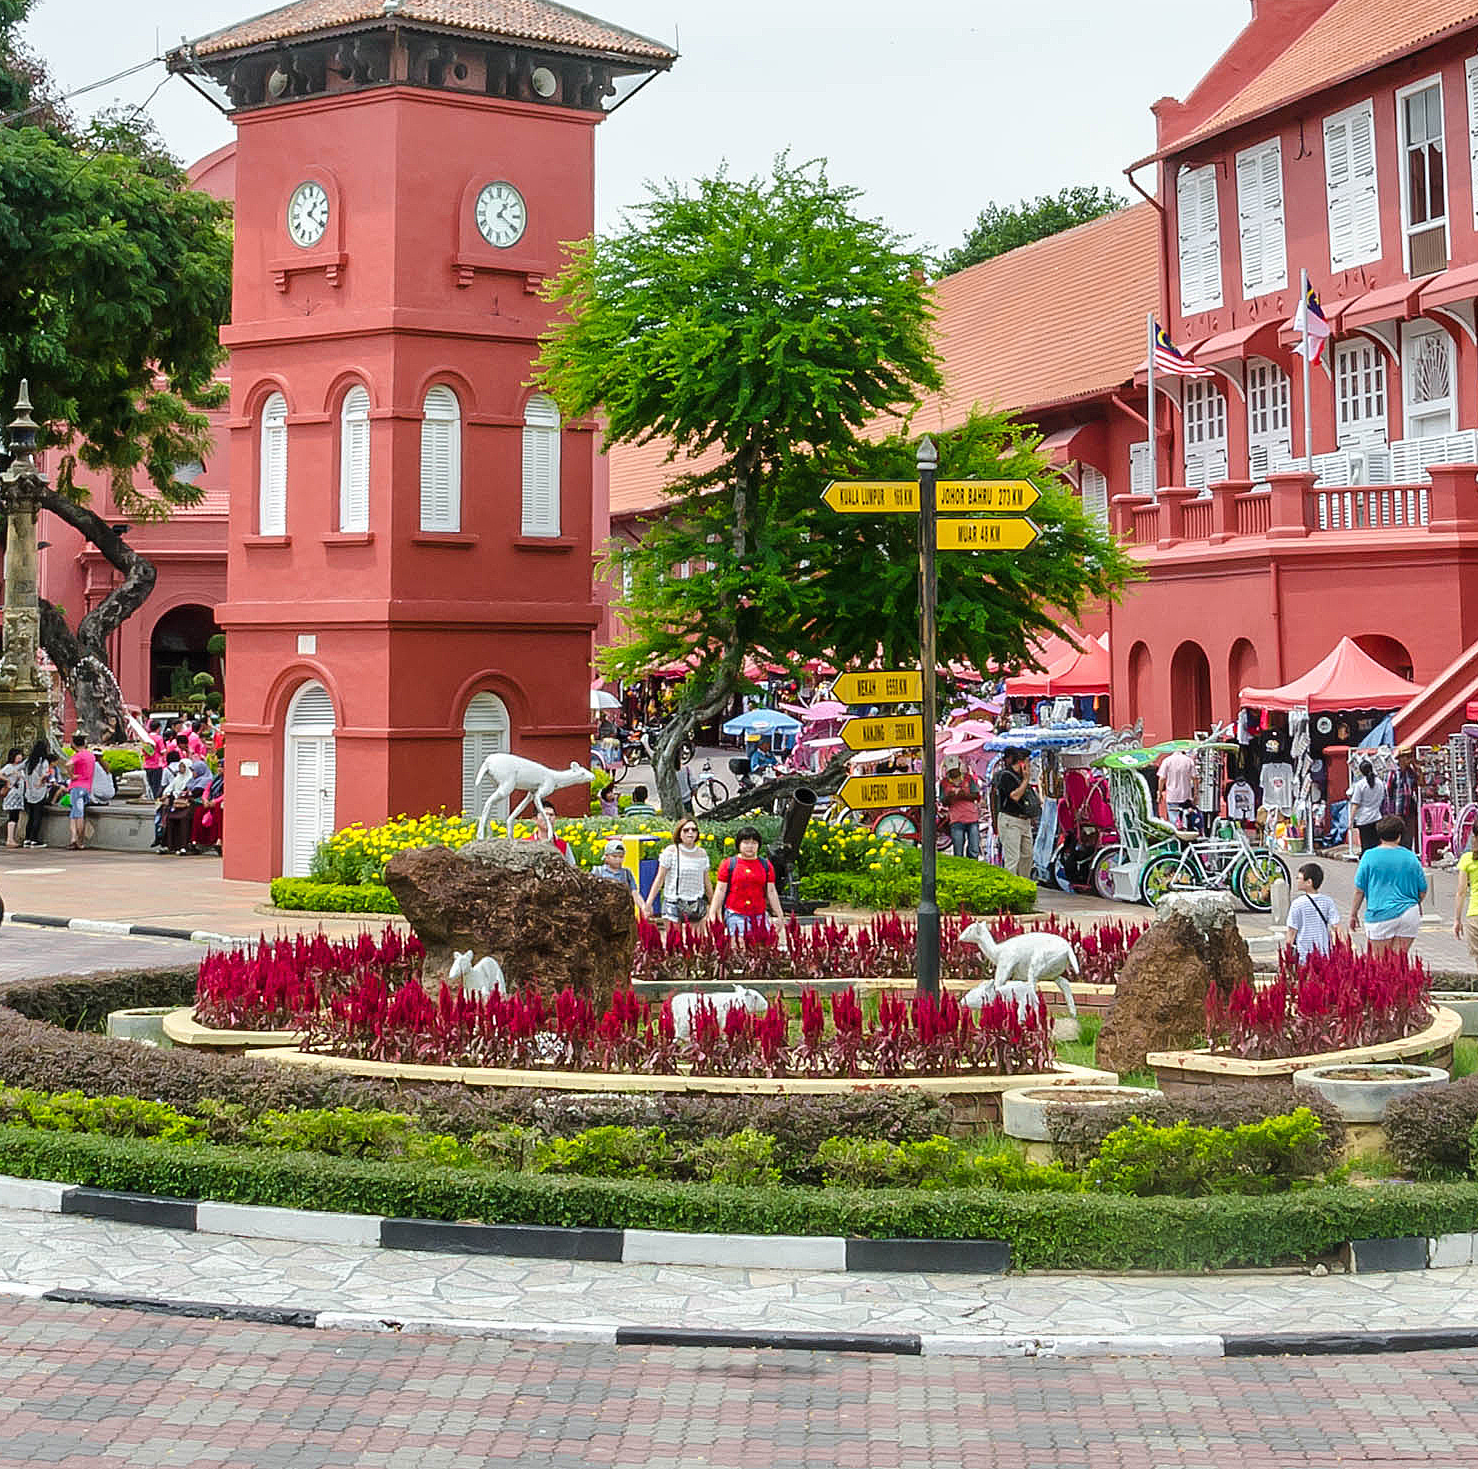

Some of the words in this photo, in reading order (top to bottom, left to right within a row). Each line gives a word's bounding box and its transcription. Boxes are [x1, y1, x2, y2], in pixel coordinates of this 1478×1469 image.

[839, 488, 859, 505] KUALA
[861, 488, 885, 505] LUMPUR
[941, 488, 965, 505] JOHOR
[968, 488, 993, 505] BAHRU
[957, 525, 978, 543] MUAR
